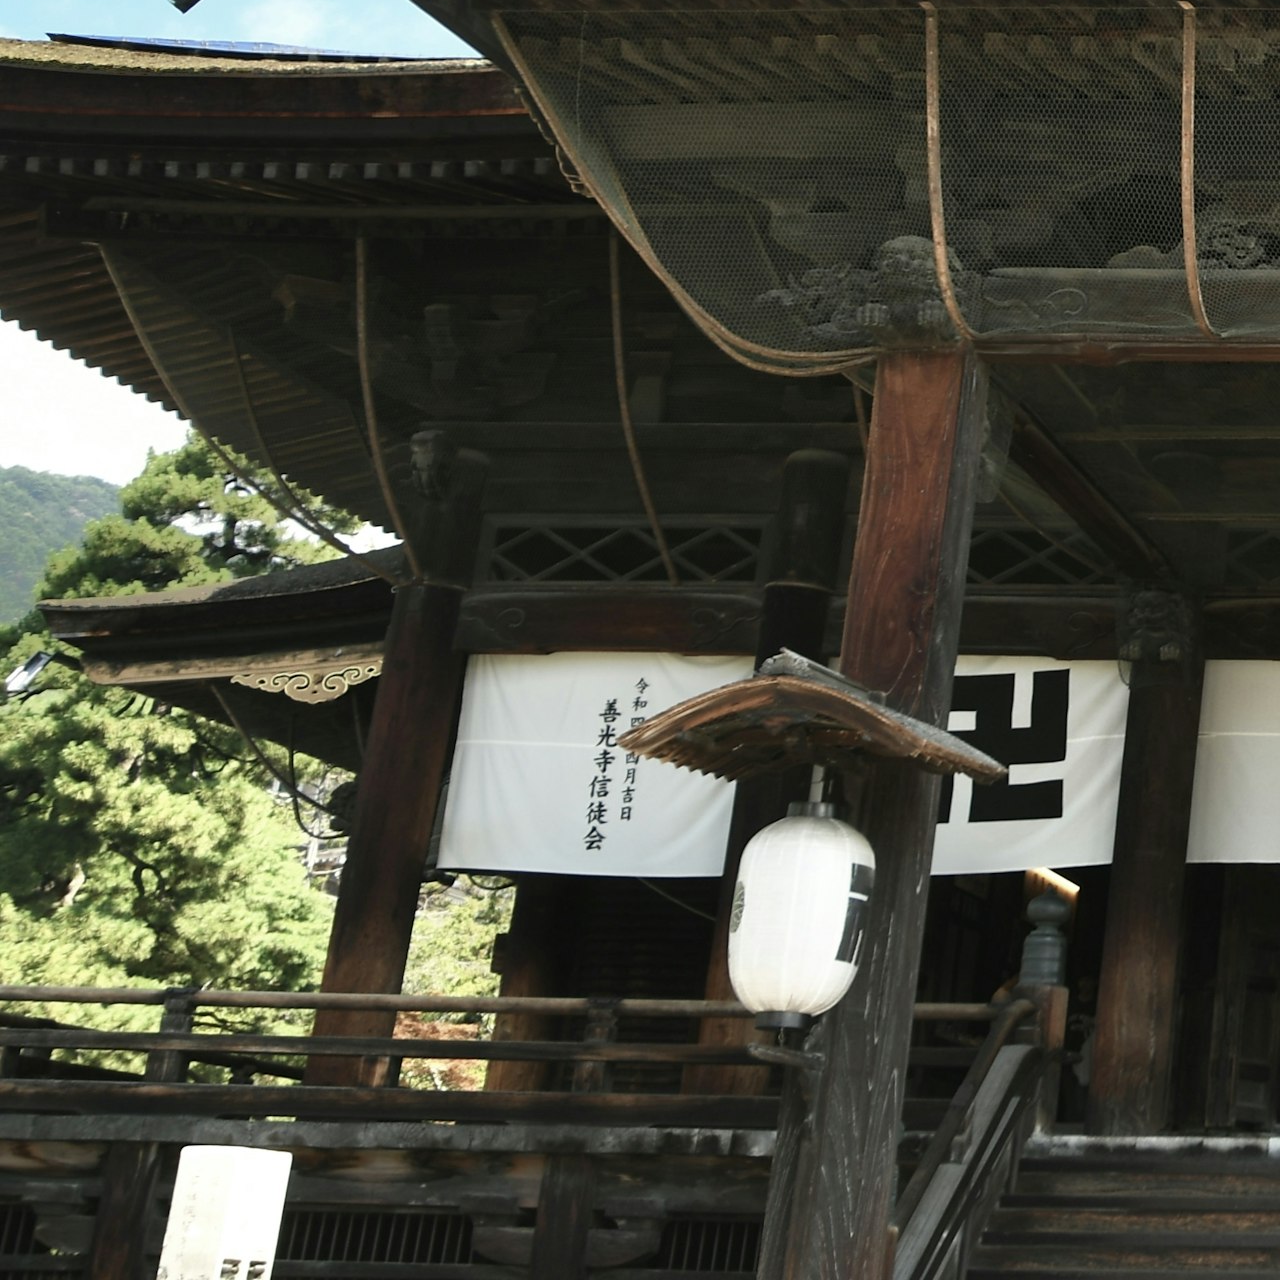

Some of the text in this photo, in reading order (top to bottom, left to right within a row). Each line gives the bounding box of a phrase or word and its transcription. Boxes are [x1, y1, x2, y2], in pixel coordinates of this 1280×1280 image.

[583, 698, 621, 851] 善光寺信徒会
[620, 677, 650, 821] 令和四四月吉日
